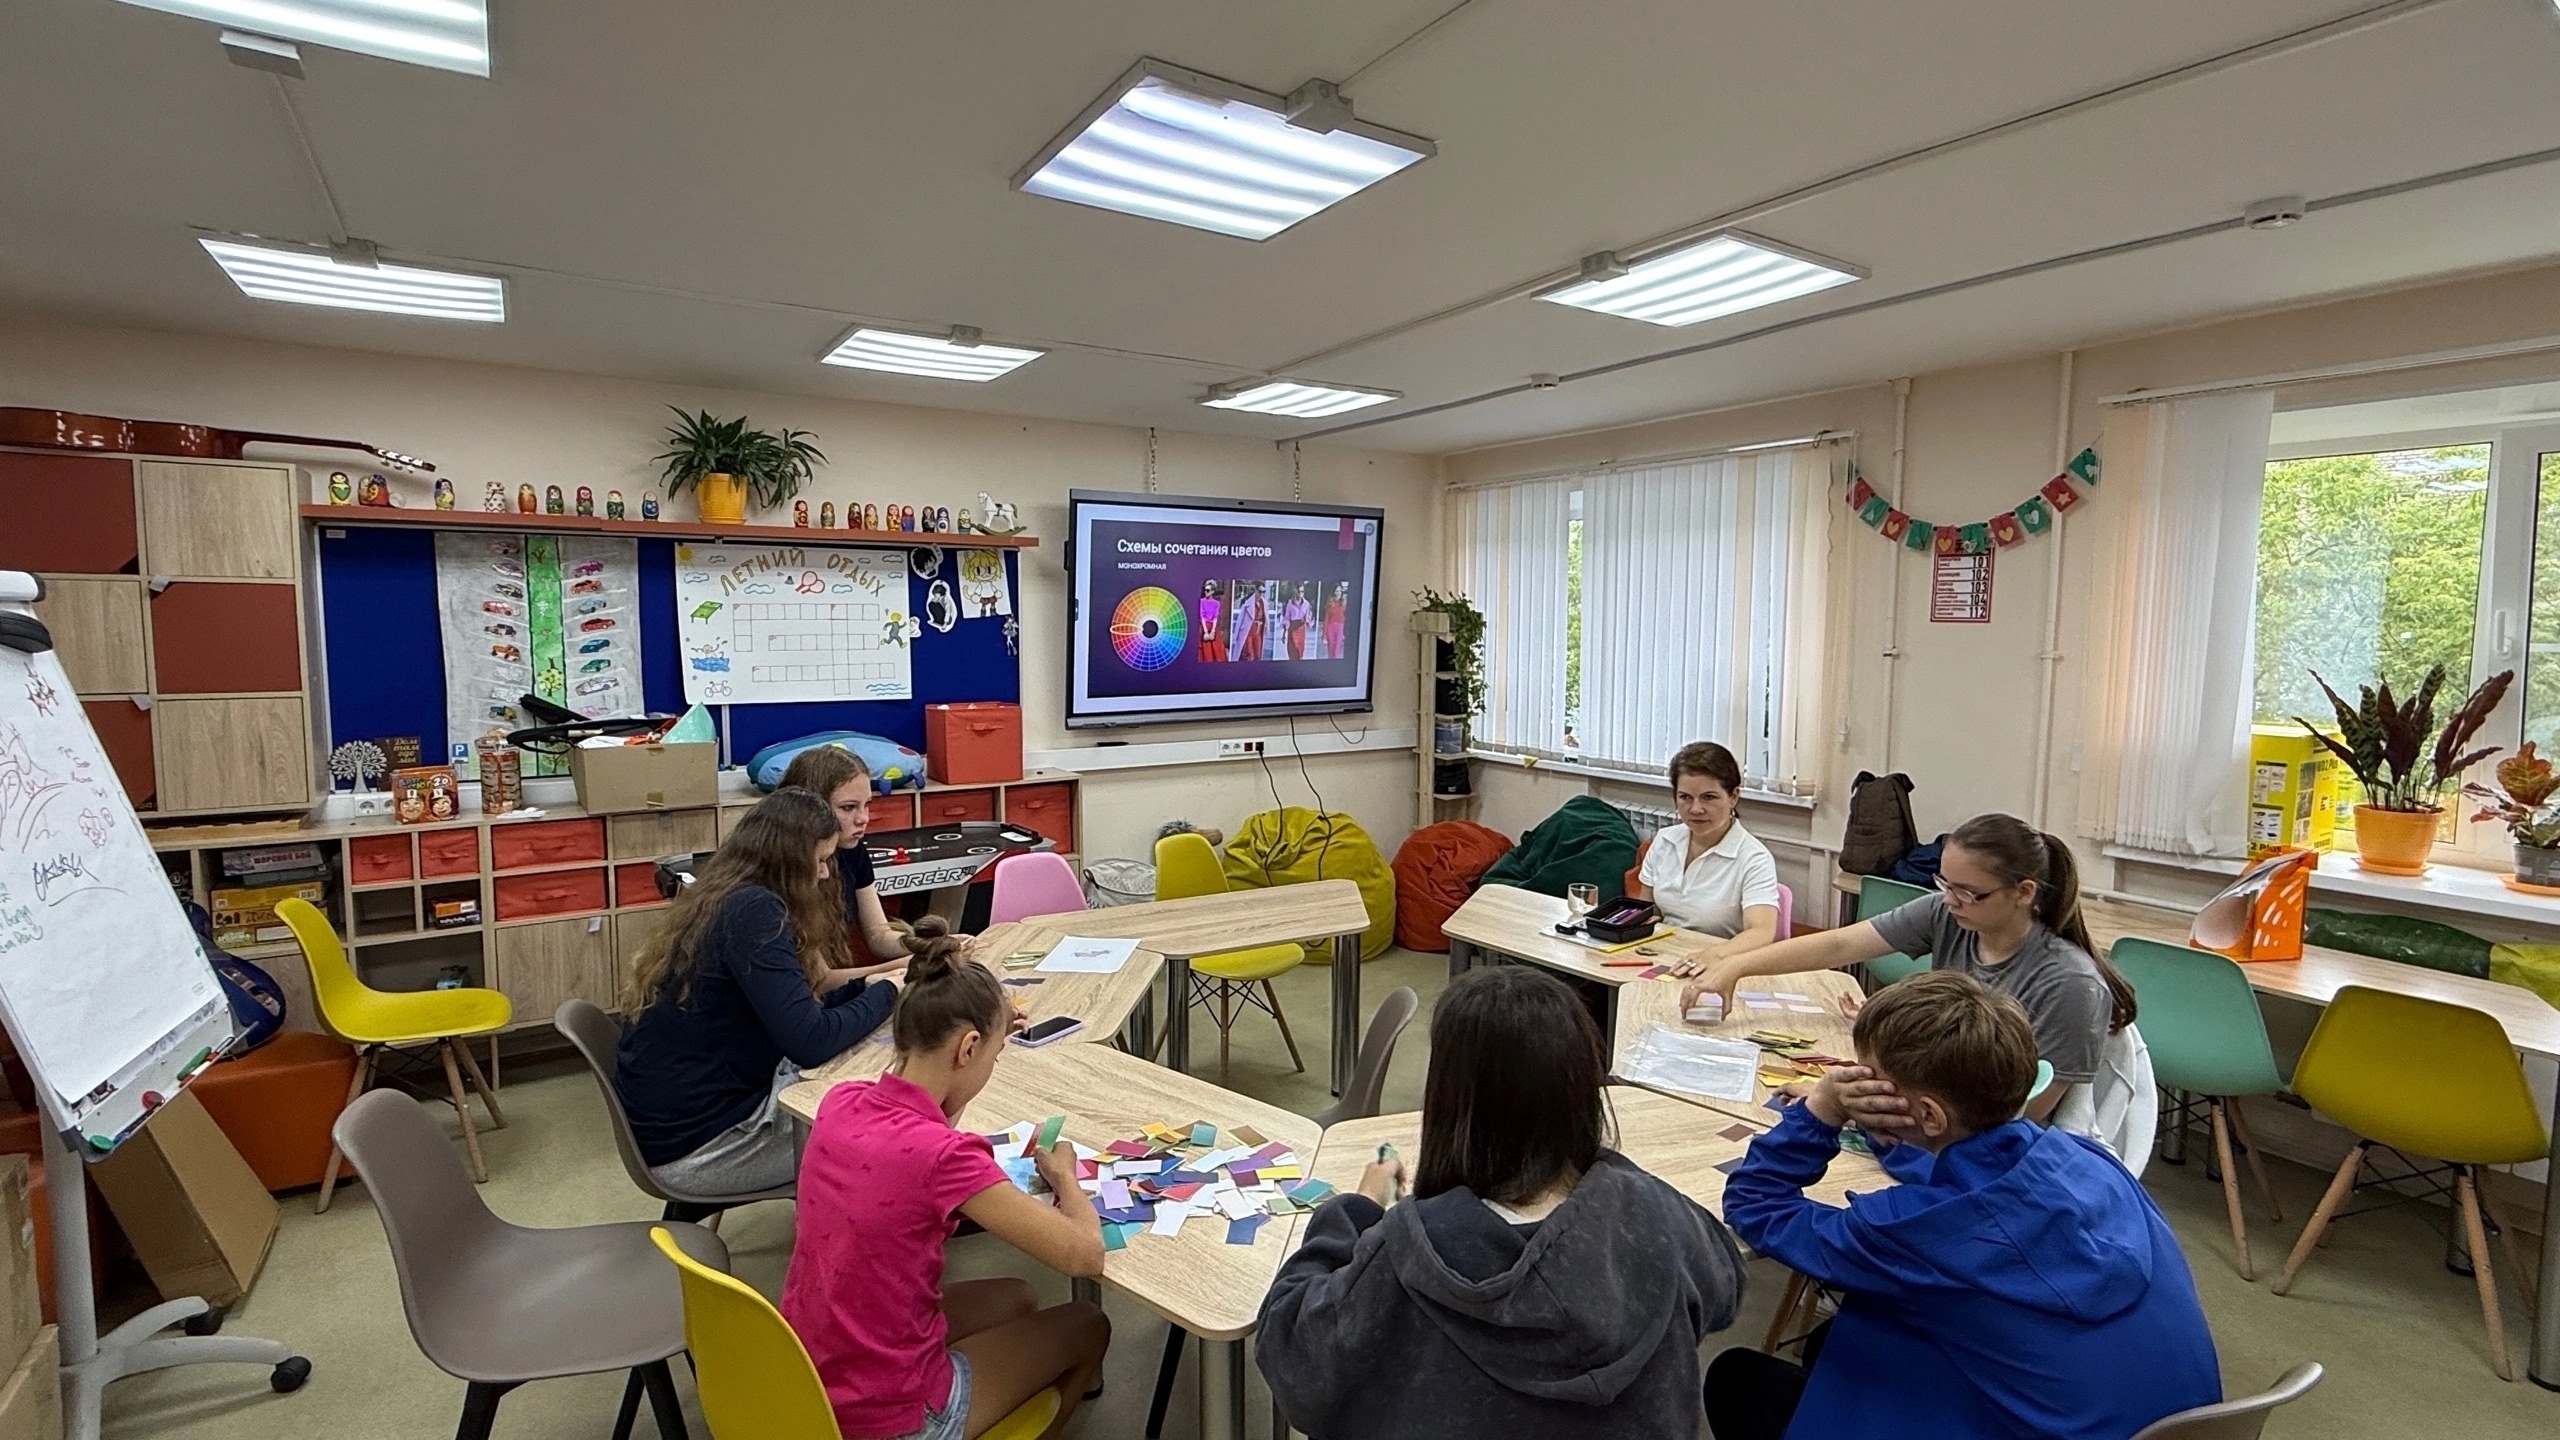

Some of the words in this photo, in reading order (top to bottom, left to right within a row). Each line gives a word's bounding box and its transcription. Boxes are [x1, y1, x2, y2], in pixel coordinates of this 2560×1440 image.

[1117, 538, 1162, 554] Схемы
[1164, 542, 1229, 556] сочетания
[1231, 545, 1272, 558] цветов
[1117, 562, 1167, 570] МОНОХРОМНАЯ
[1973, 556, 1990, 568] 101
[720, 547, 806, 597] ЛЕТНИЙ
[827, 553, 886, 597] ОТДЫХ
[1972, 569, 1989, 581] 102
[1971, 581, 1988, 593] 103
[1970, 594, 1987, 606] 104
[1969, 606, 1986, 618] 112
